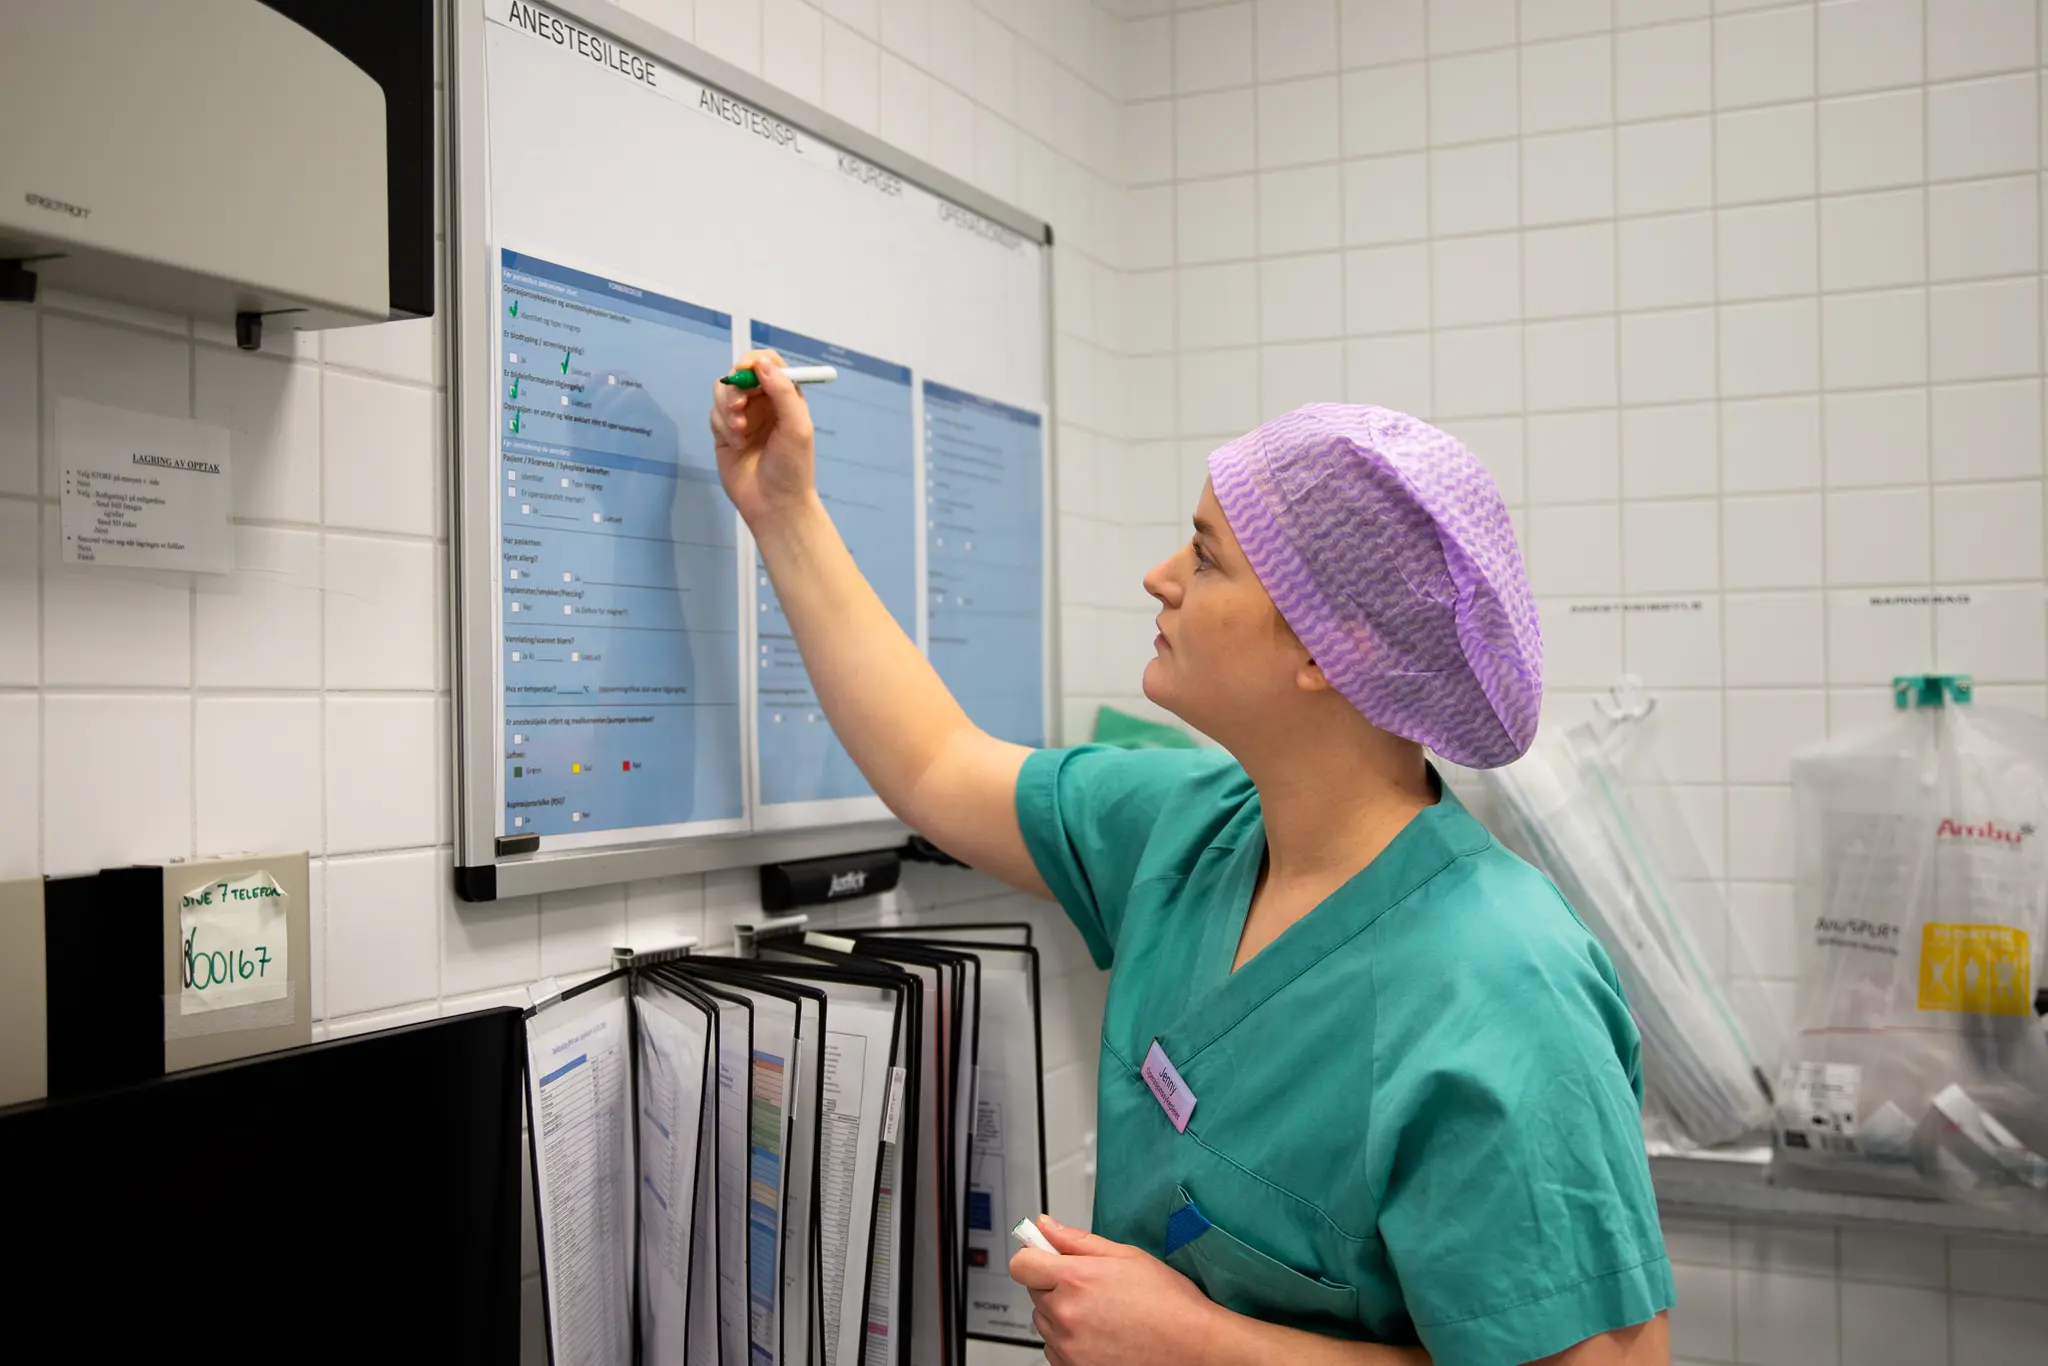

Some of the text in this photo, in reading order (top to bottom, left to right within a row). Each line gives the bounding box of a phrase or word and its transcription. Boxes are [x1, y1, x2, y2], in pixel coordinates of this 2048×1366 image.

[508, 0, 657, 87] ANESTESILEGE
[699, 88, 804, 154] ANESTESISPL
[836, 150, 903, 197] KIRURGER
[132, 453, 220, 473] LAGRING AV OPPTAK
[1936, 817, 2022, 845] Ambu
[217, 883, 228, 902] 7
[1159, 1067, 1177, 1097] Jenny
[973, 1301, 1009, 1314] SONY
